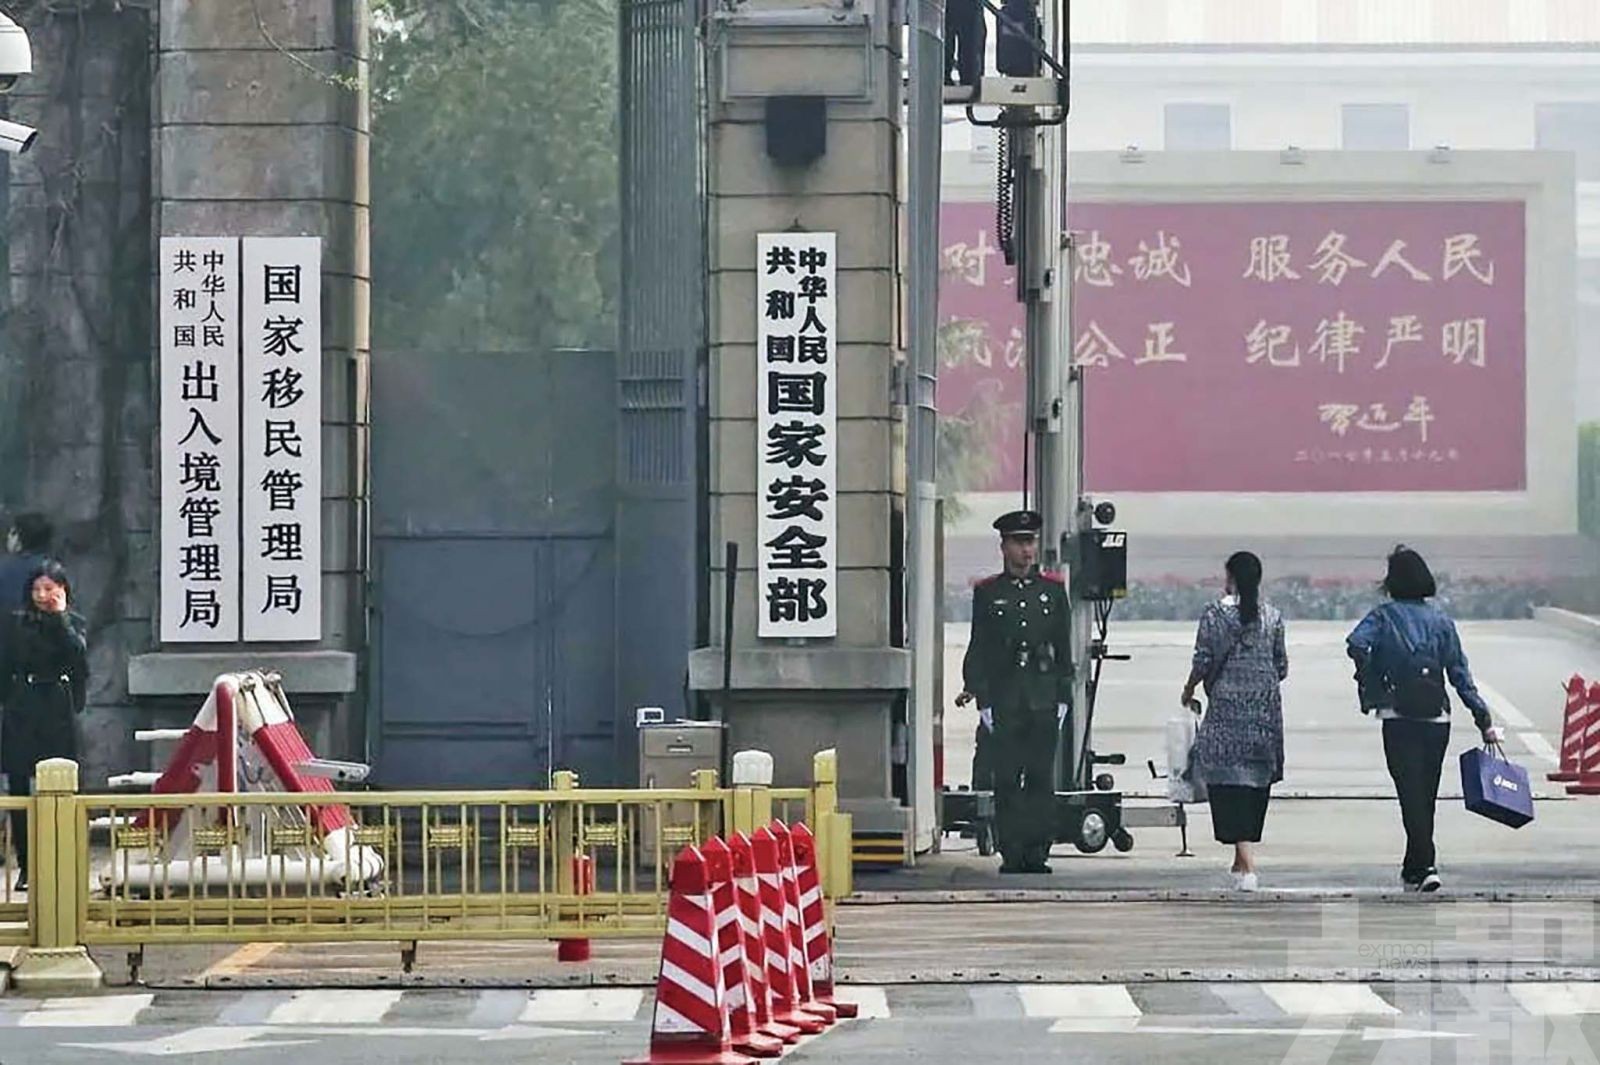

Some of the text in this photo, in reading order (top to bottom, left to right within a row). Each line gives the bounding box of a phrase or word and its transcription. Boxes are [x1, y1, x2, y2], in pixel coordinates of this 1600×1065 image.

[173, 249, 197, 348] 共和国
[202, 249, 225, 347] 中华人民
[765, 246, 796, 364] 共和国
[798, 246, 828, 365] 中华人民
[942, 229, 1494, 287] 对忠诚 服务人民
[1244, 310, 1487, 374] 纪律严明
[178, 360, 223, 629] 出入境管理局
[260, 264, 304, 615] 国家移民管理局
[764, 371, 829, 623] 国家安全部
